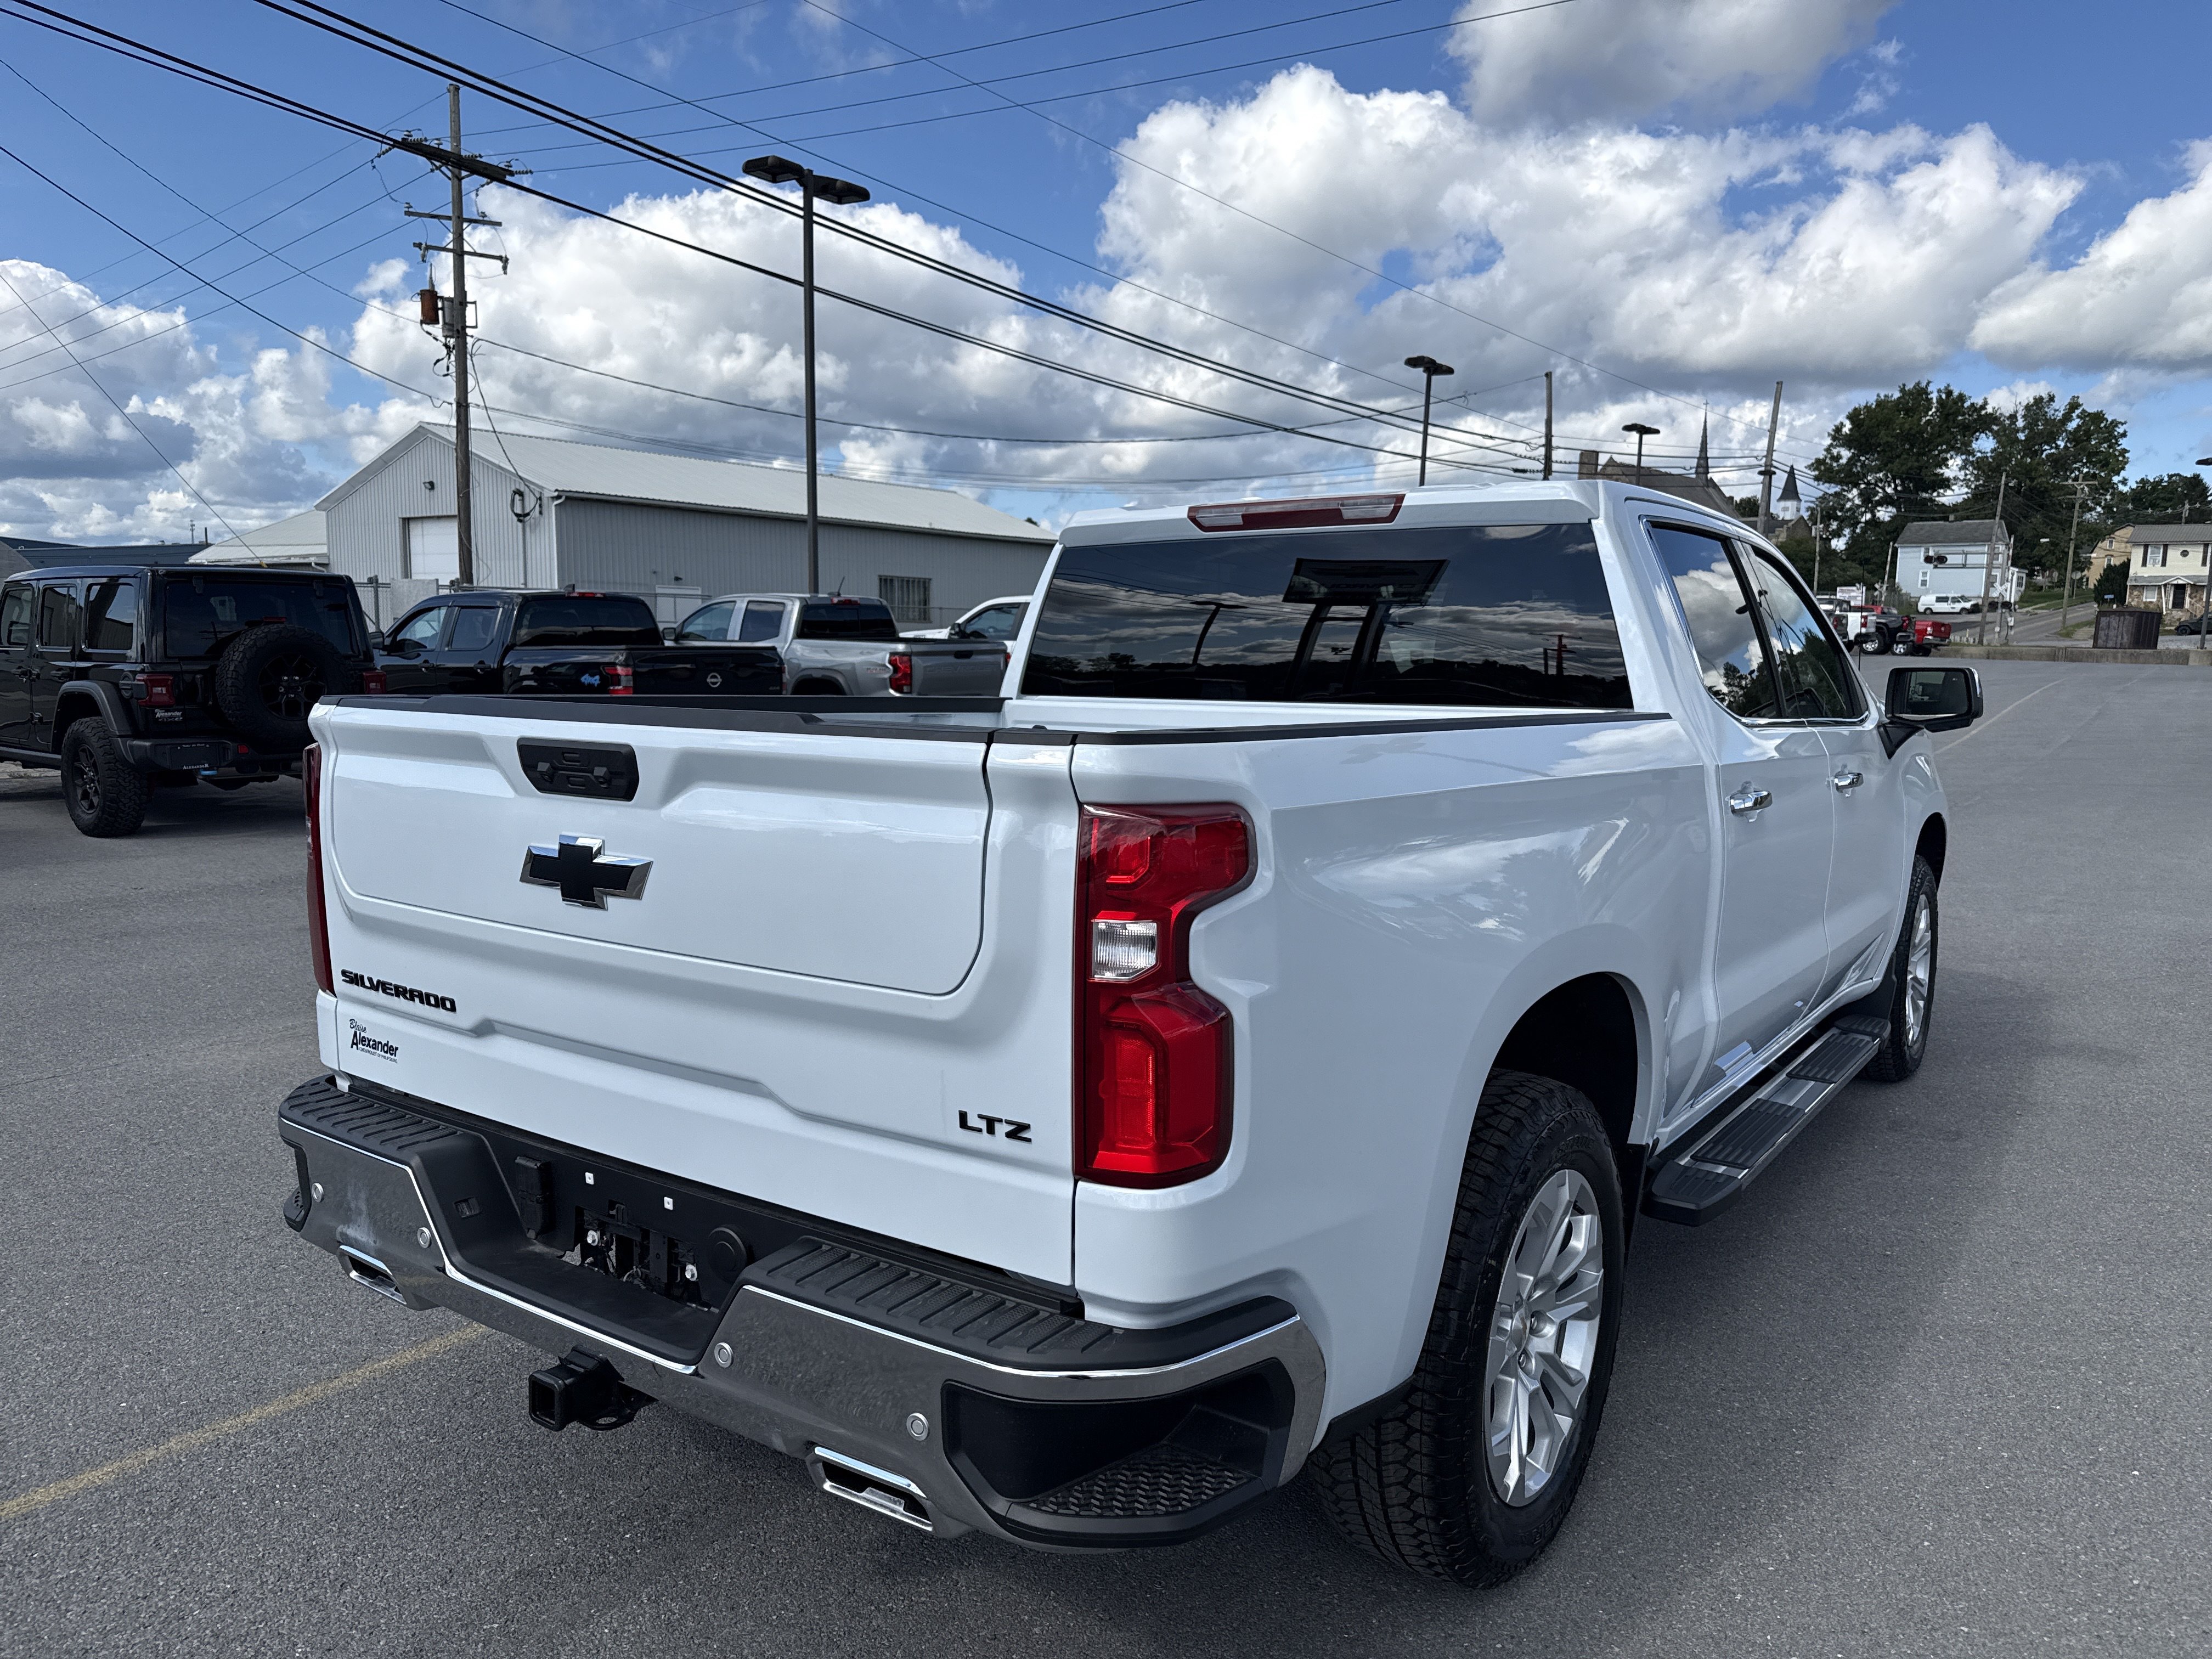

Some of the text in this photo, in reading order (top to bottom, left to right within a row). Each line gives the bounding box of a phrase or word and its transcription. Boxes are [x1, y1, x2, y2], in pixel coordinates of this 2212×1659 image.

[341, 969, 456, 1012] SILVERADO
[349, 1018, 367, 1033] Blaise
[351, 1030, 399, 1057] Alexander
[958, 1110, 1032, 1142] LTZ
